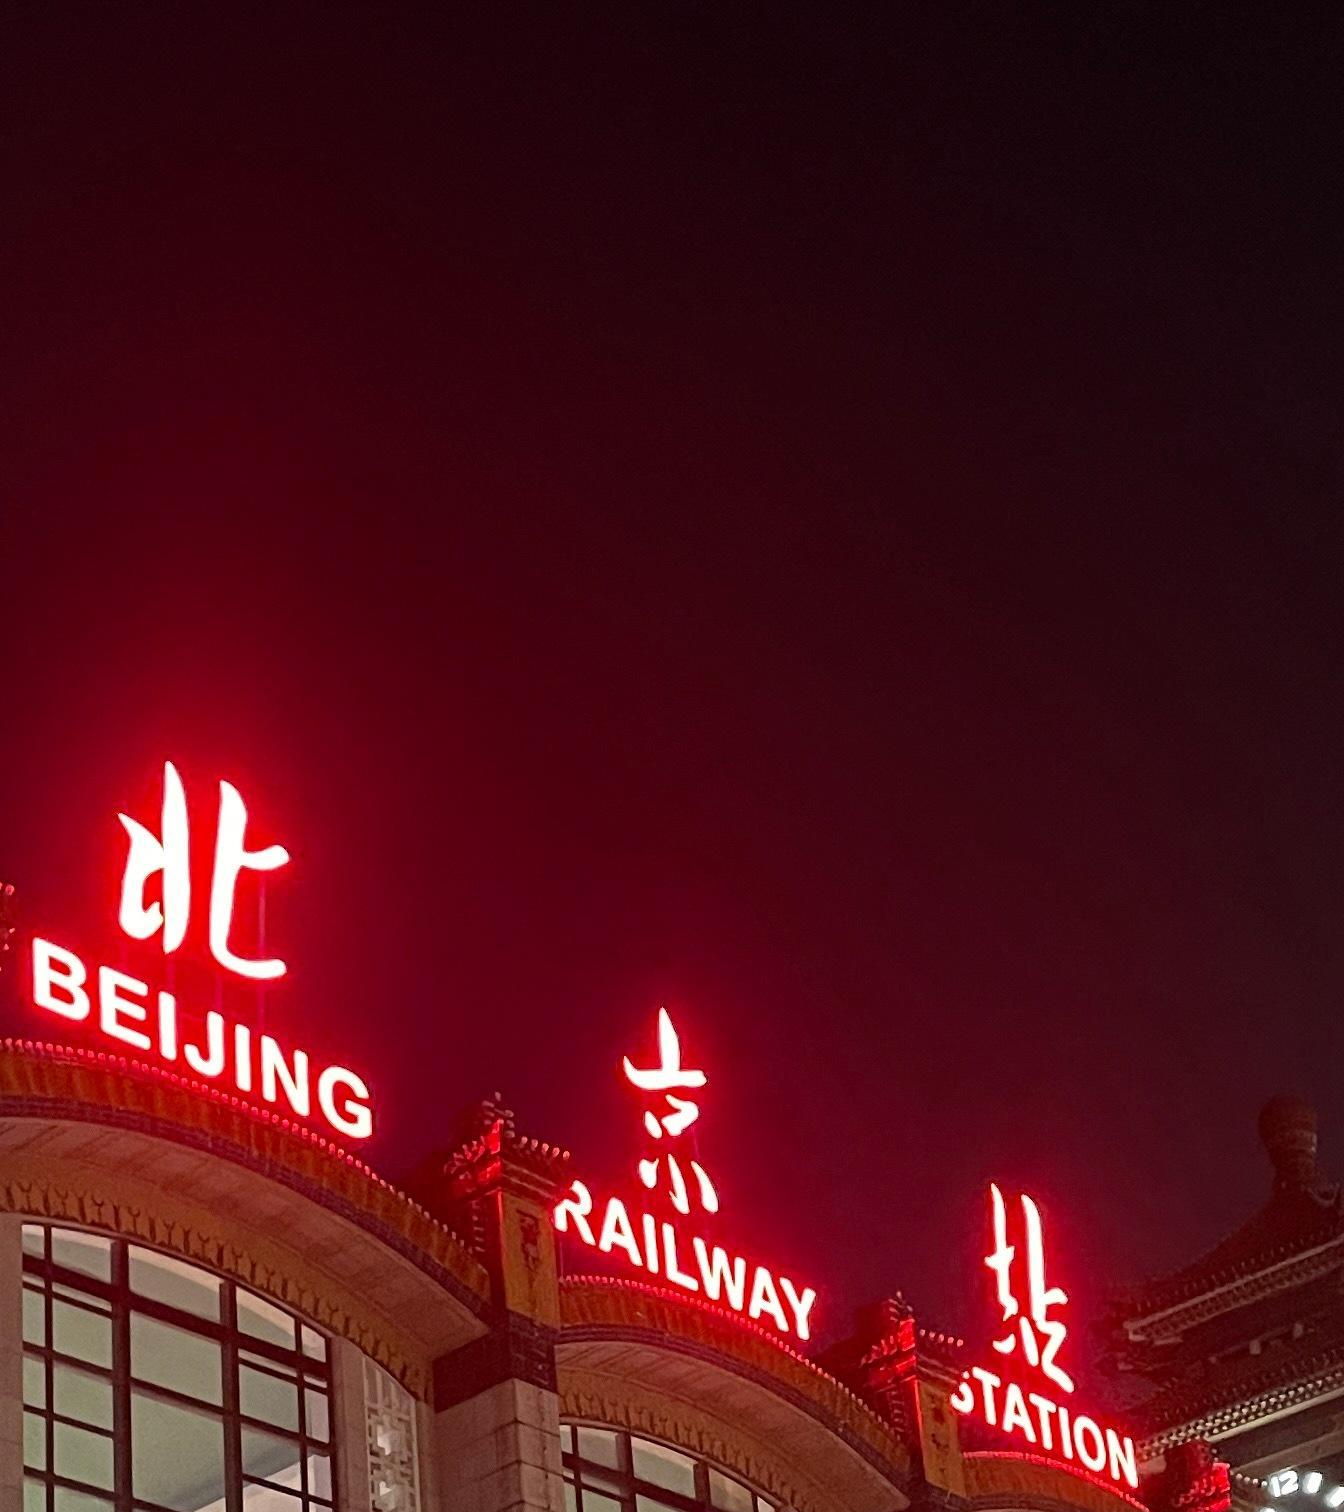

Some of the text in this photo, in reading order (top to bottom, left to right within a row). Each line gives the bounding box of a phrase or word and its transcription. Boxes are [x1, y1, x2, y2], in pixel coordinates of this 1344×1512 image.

[32, 936, 373, 1139] BEIJING
[553, 1179, 817, 1341] RAILWAY
[118, 760, 1075, 1393] 北 京 站
[1269, 1469, 1300, 1498] 12
